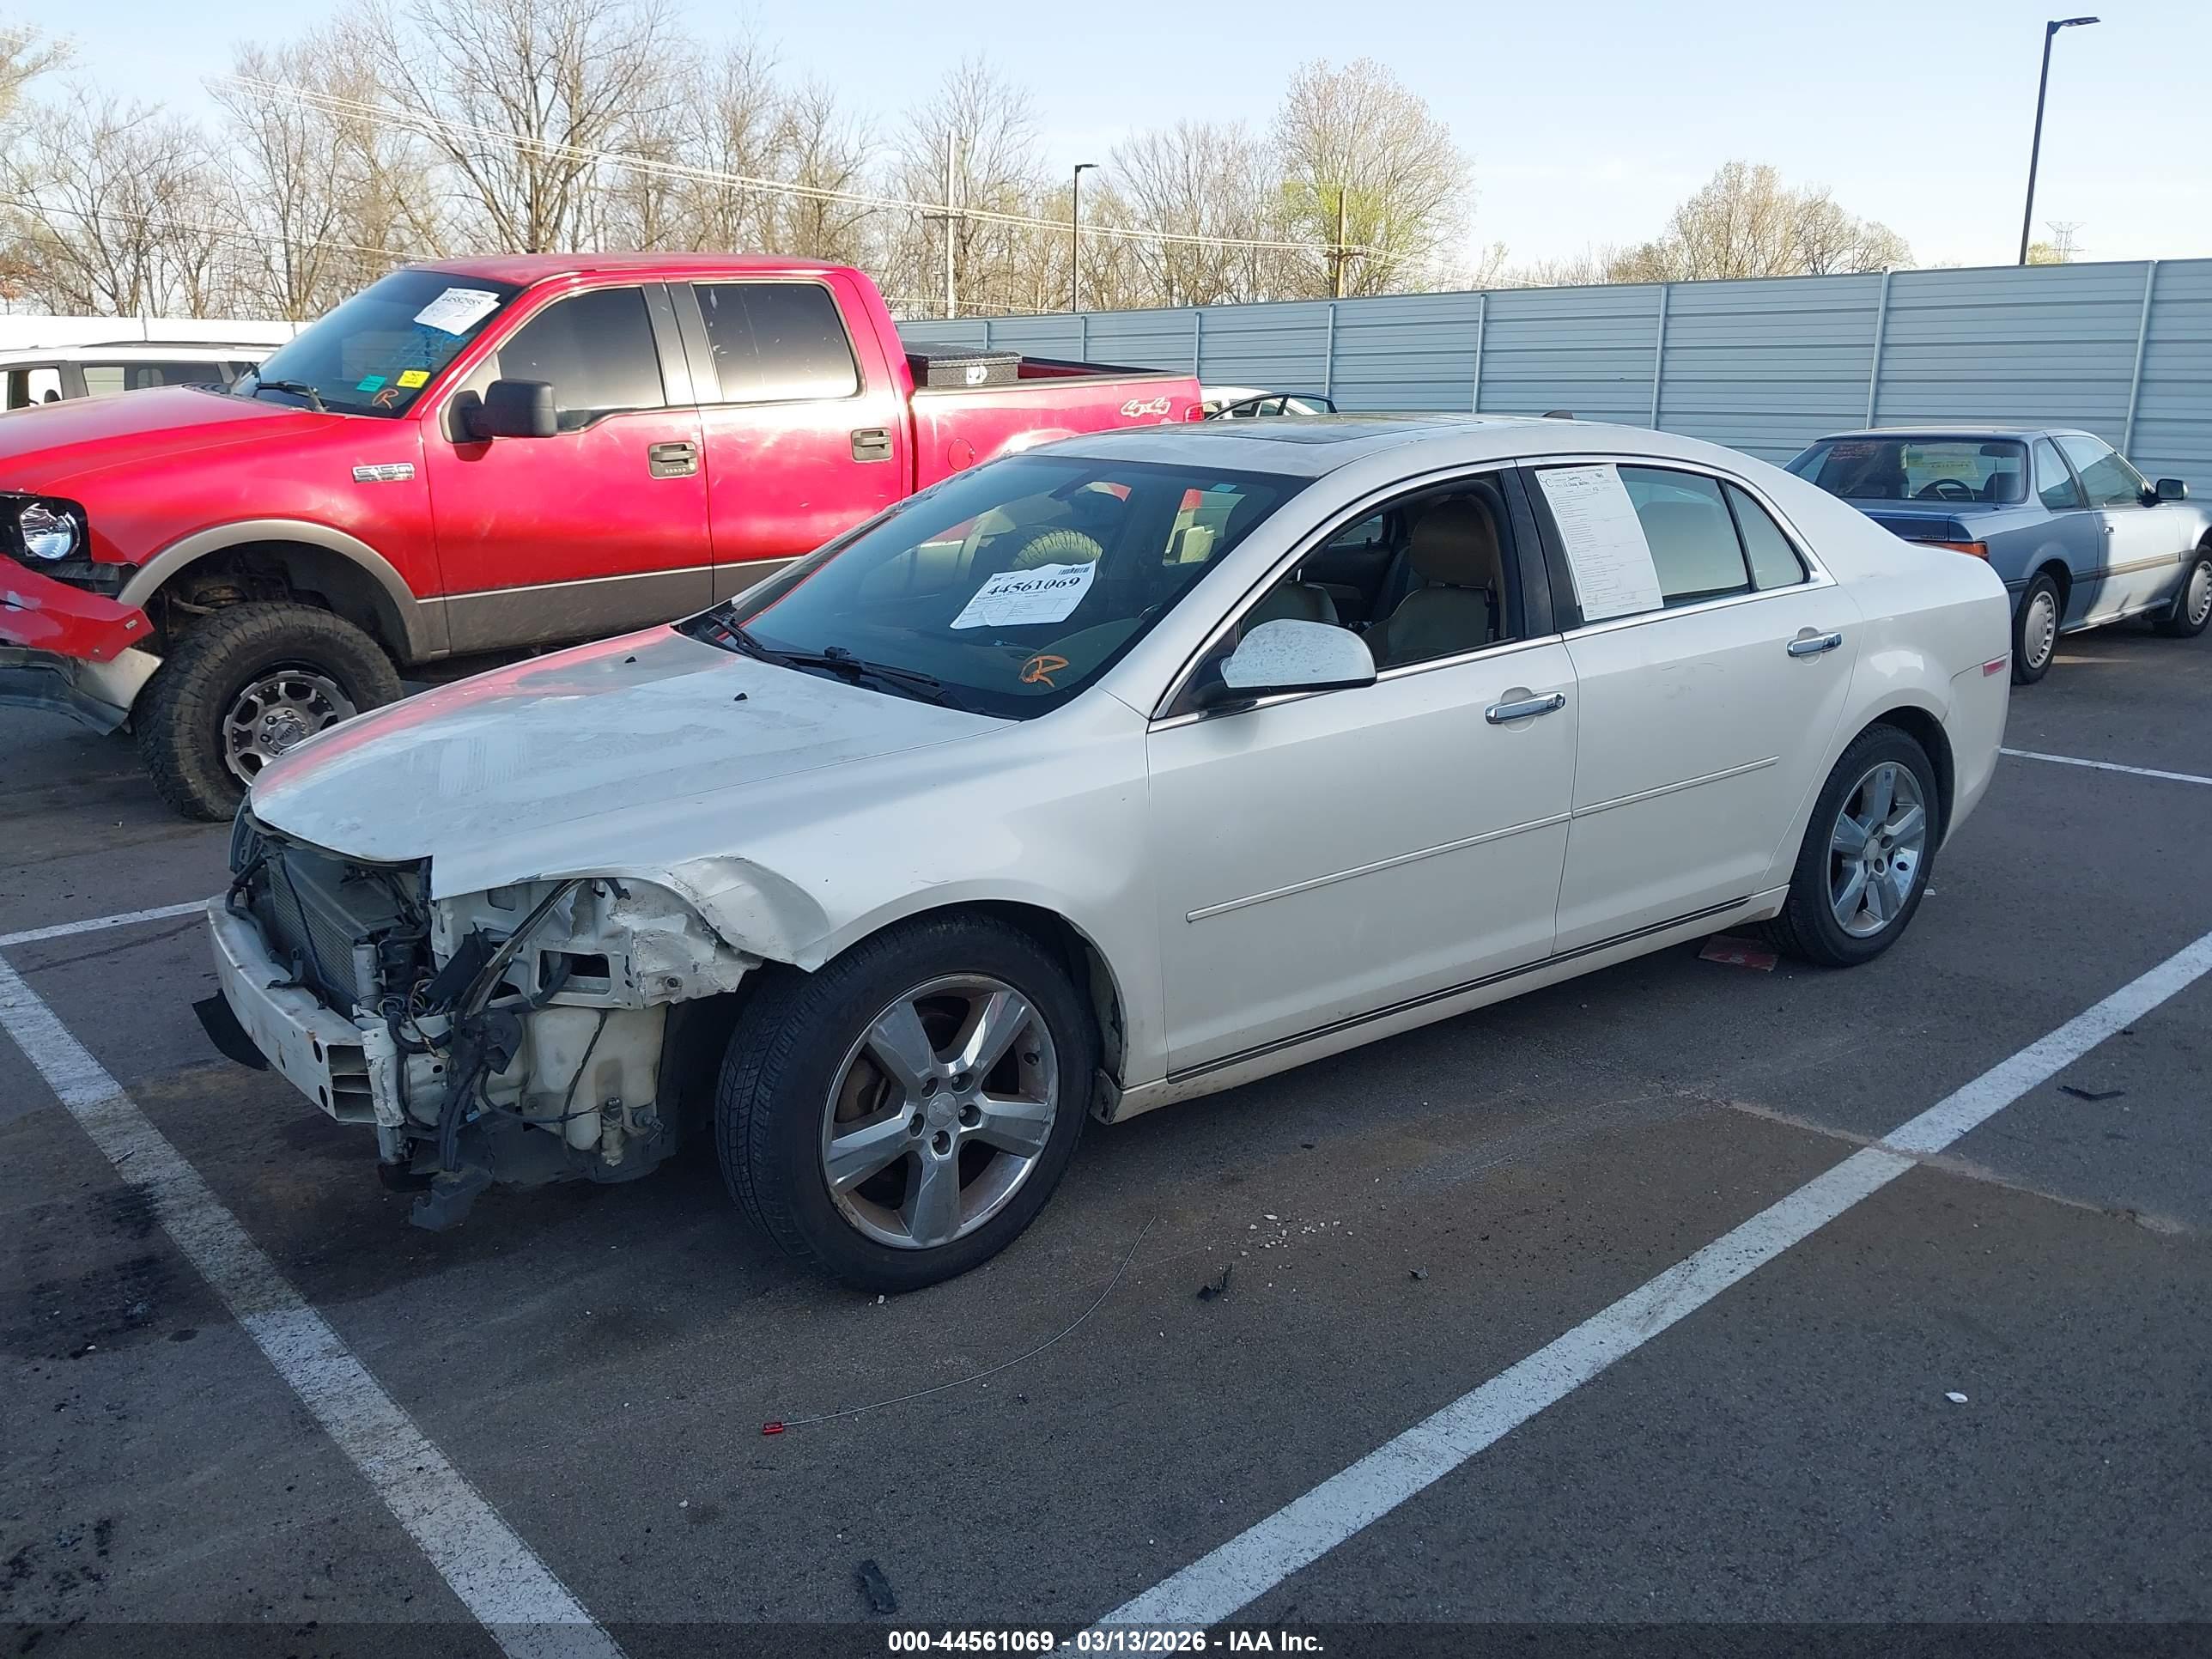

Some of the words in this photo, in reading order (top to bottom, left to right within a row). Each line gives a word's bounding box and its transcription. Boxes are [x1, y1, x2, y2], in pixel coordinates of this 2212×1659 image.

[372, 388, 399, 410] R
[988, 576, 1081, 596] 44561069
[1018, 655, 1070, 688] R
